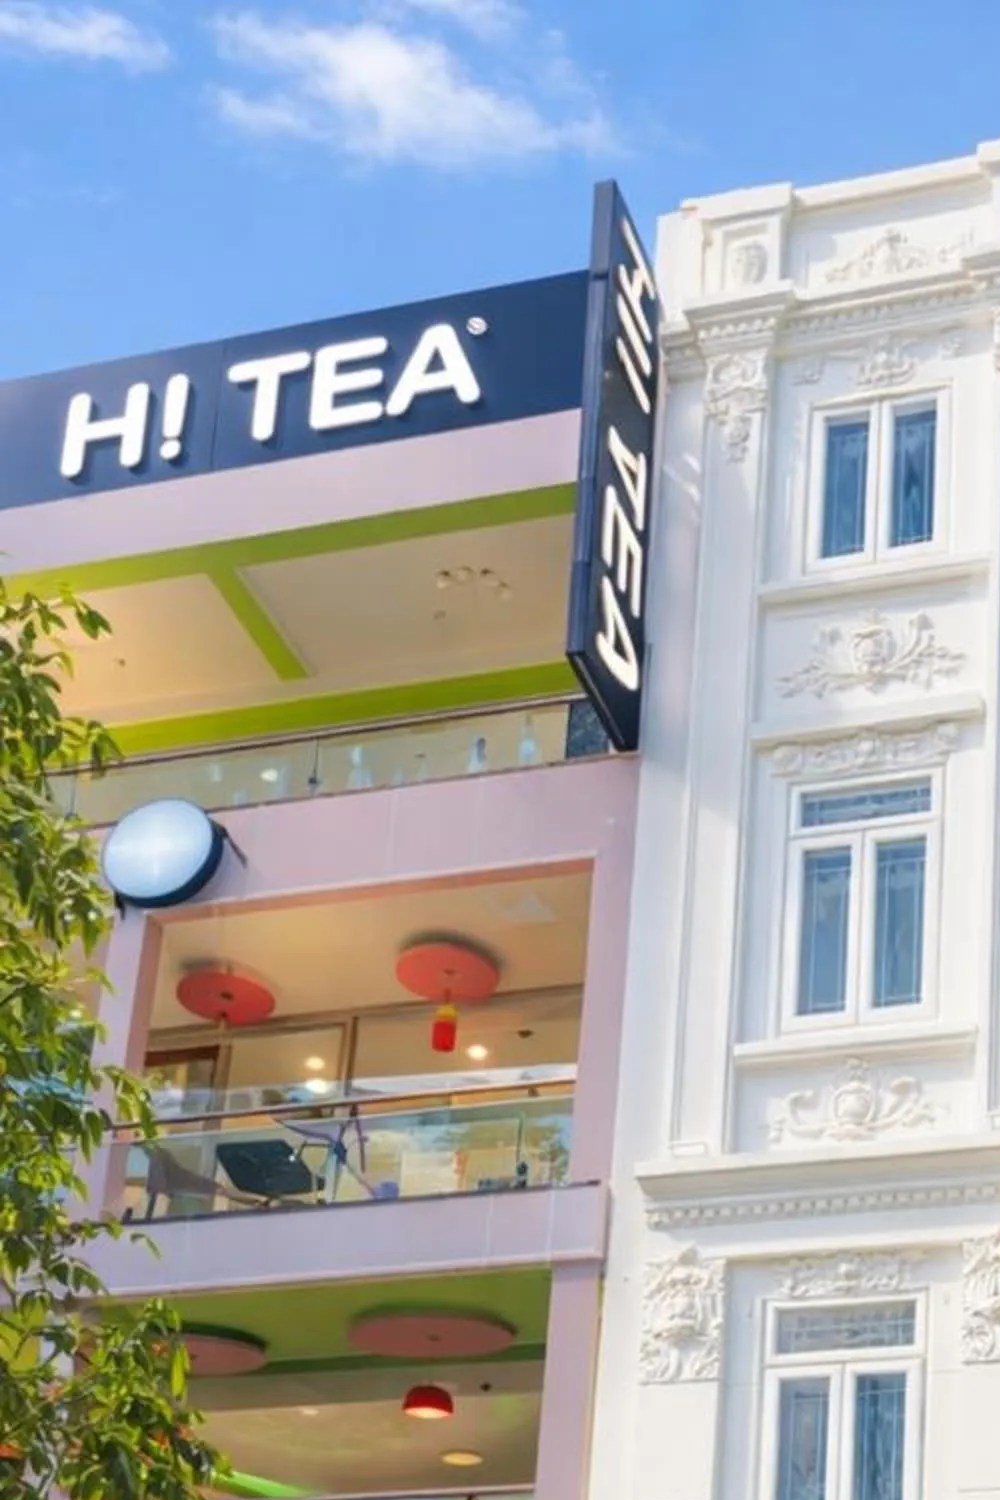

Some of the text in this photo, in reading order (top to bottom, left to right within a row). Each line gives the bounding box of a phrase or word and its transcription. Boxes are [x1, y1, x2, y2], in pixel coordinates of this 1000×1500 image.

[59, 323, 482, 479] H! TEA
[597, 425, 648, 691] TEA
